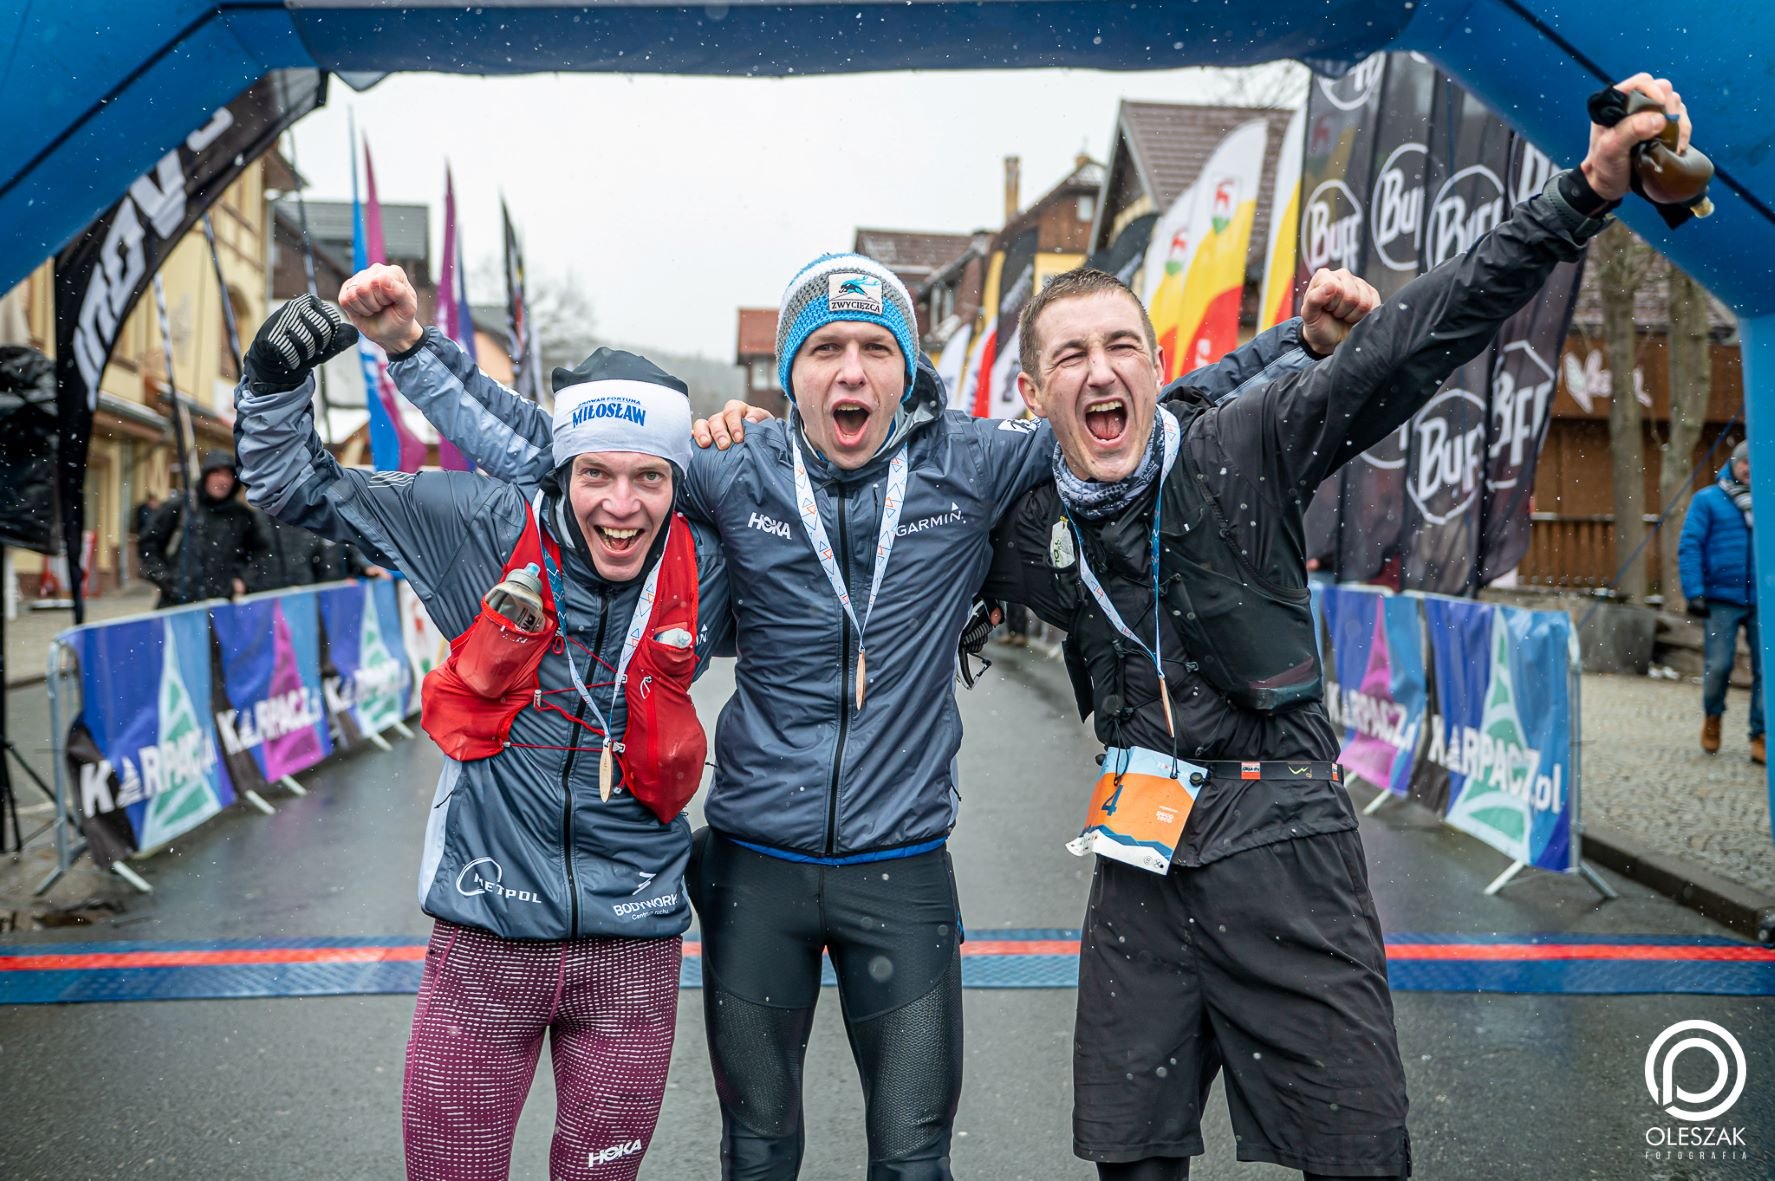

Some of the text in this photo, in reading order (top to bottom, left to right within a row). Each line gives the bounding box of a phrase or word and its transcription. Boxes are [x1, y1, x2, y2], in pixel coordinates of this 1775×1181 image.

[572, 402, 646, 429] MIŁOSŁAW
[748, 511, 792, 540] HOKA
[896, 510, 962, 538] GARMIN
[1101, 784, 1124, 817] 4
[587, 1138, 643, 1168] HOKA
